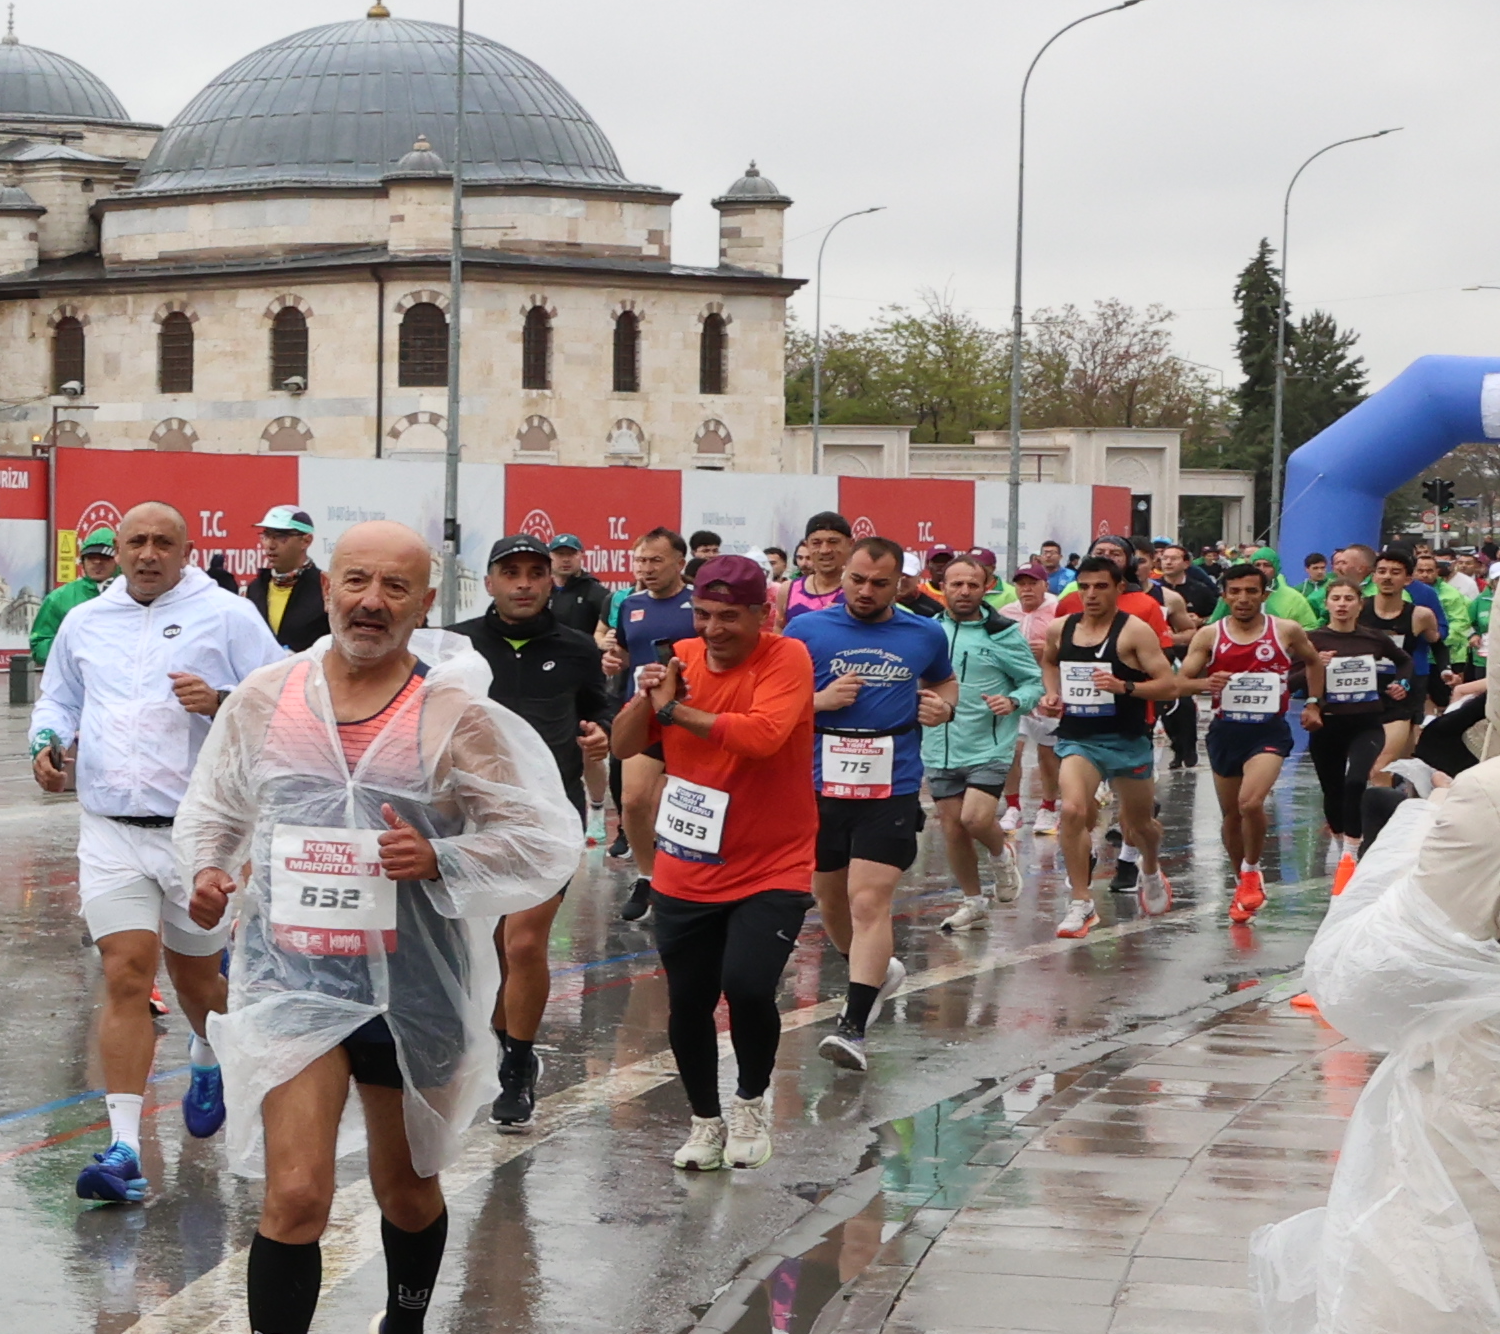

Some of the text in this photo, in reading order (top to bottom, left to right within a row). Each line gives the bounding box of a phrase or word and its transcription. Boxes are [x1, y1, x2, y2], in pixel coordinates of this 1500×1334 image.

[200, 510, 228, 538] T.C.
[608, 517, 629, 539] T.C.
[582, 545, 626, 573] TÜR VE
[829, 657, 913, 682] Runtalya
[1335, 677, 1369, 687] 5025
[840, 760, 871, 774] 775
[666, 813, 708, 840] 4853
[313, 852, 348, 863] YARI
[300, 886, 361, 909] 632
